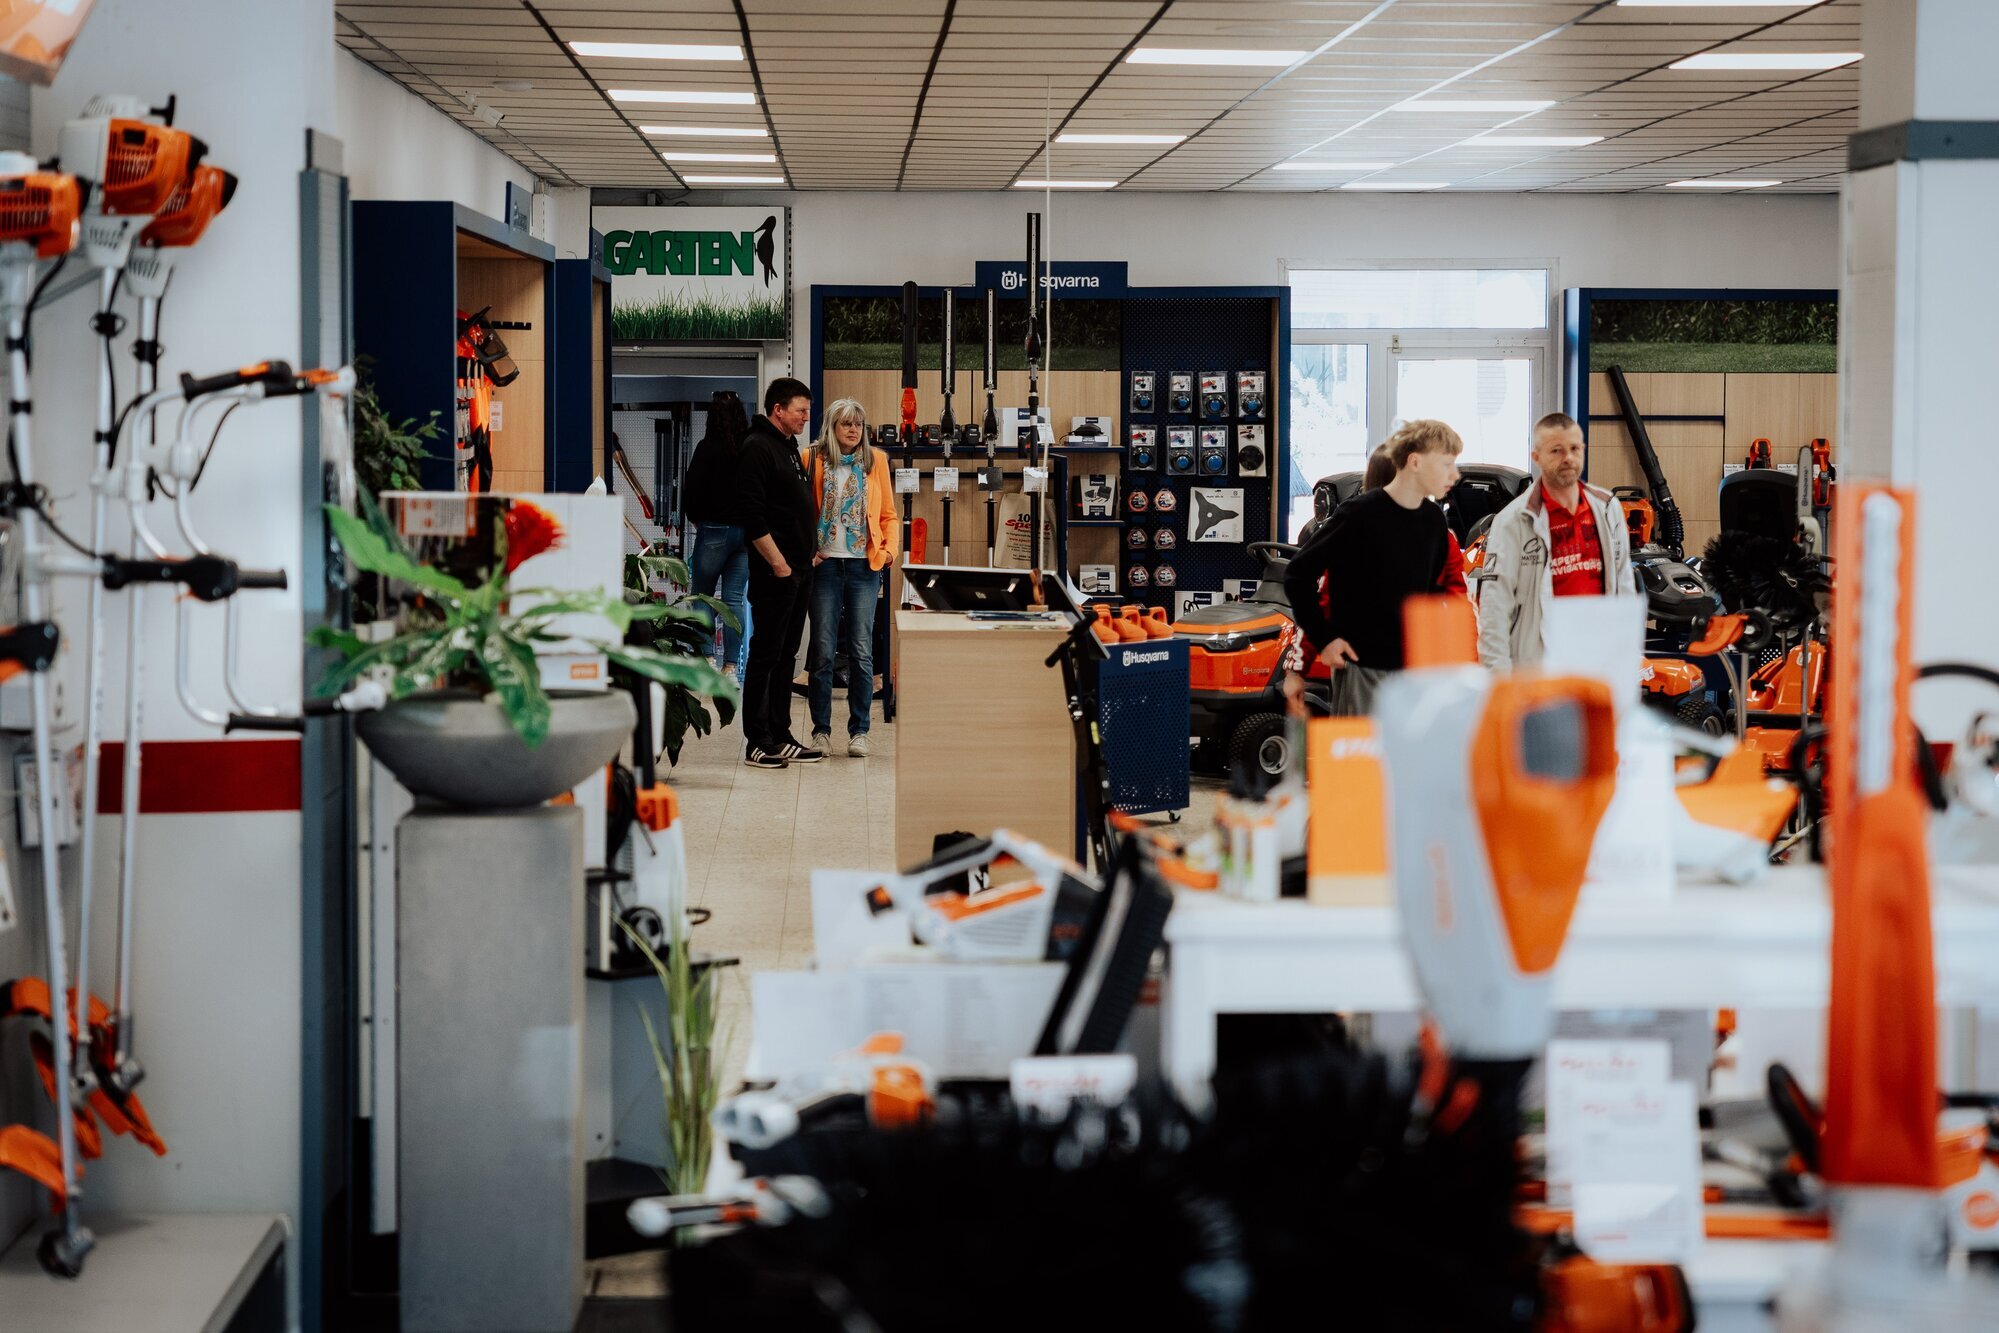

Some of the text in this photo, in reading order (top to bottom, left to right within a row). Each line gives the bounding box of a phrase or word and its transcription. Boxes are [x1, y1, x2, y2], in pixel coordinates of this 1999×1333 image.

[603, 229, 755, 276] GARTEN
[1018, 273, 1100, 290] Hsqvarna
[1130, 651, 1169, 664] Husqvarna
